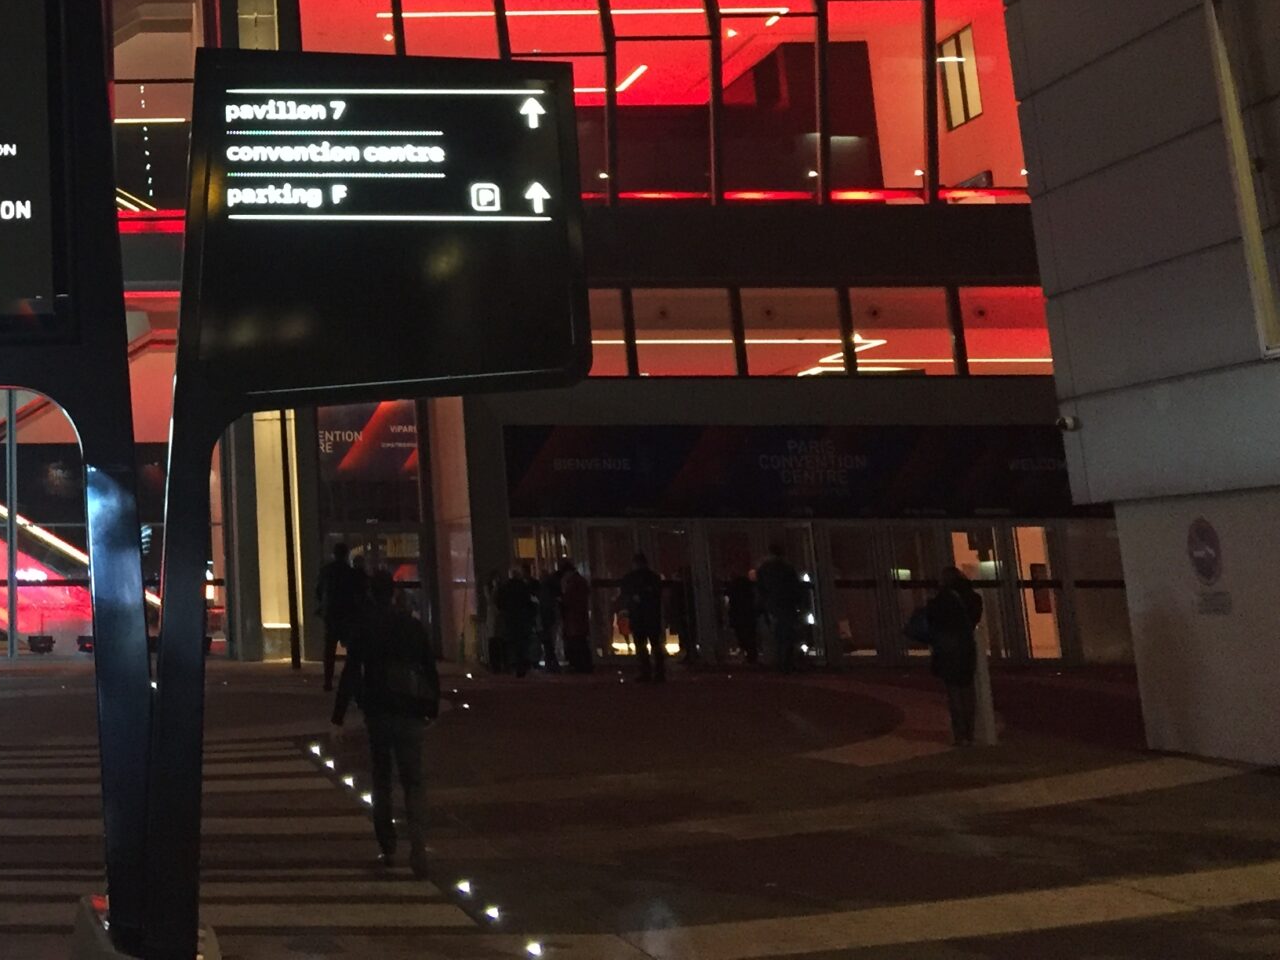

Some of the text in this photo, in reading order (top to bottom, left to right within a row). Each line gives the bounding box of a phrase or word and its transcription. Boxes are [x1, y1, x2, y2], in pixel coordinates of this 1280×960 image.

[329, 100, 346, 120] 7
[226, 141, 445, 162] convention centre
[227, 183, 322, 208] parking
[331, 184, 348, 204] F
